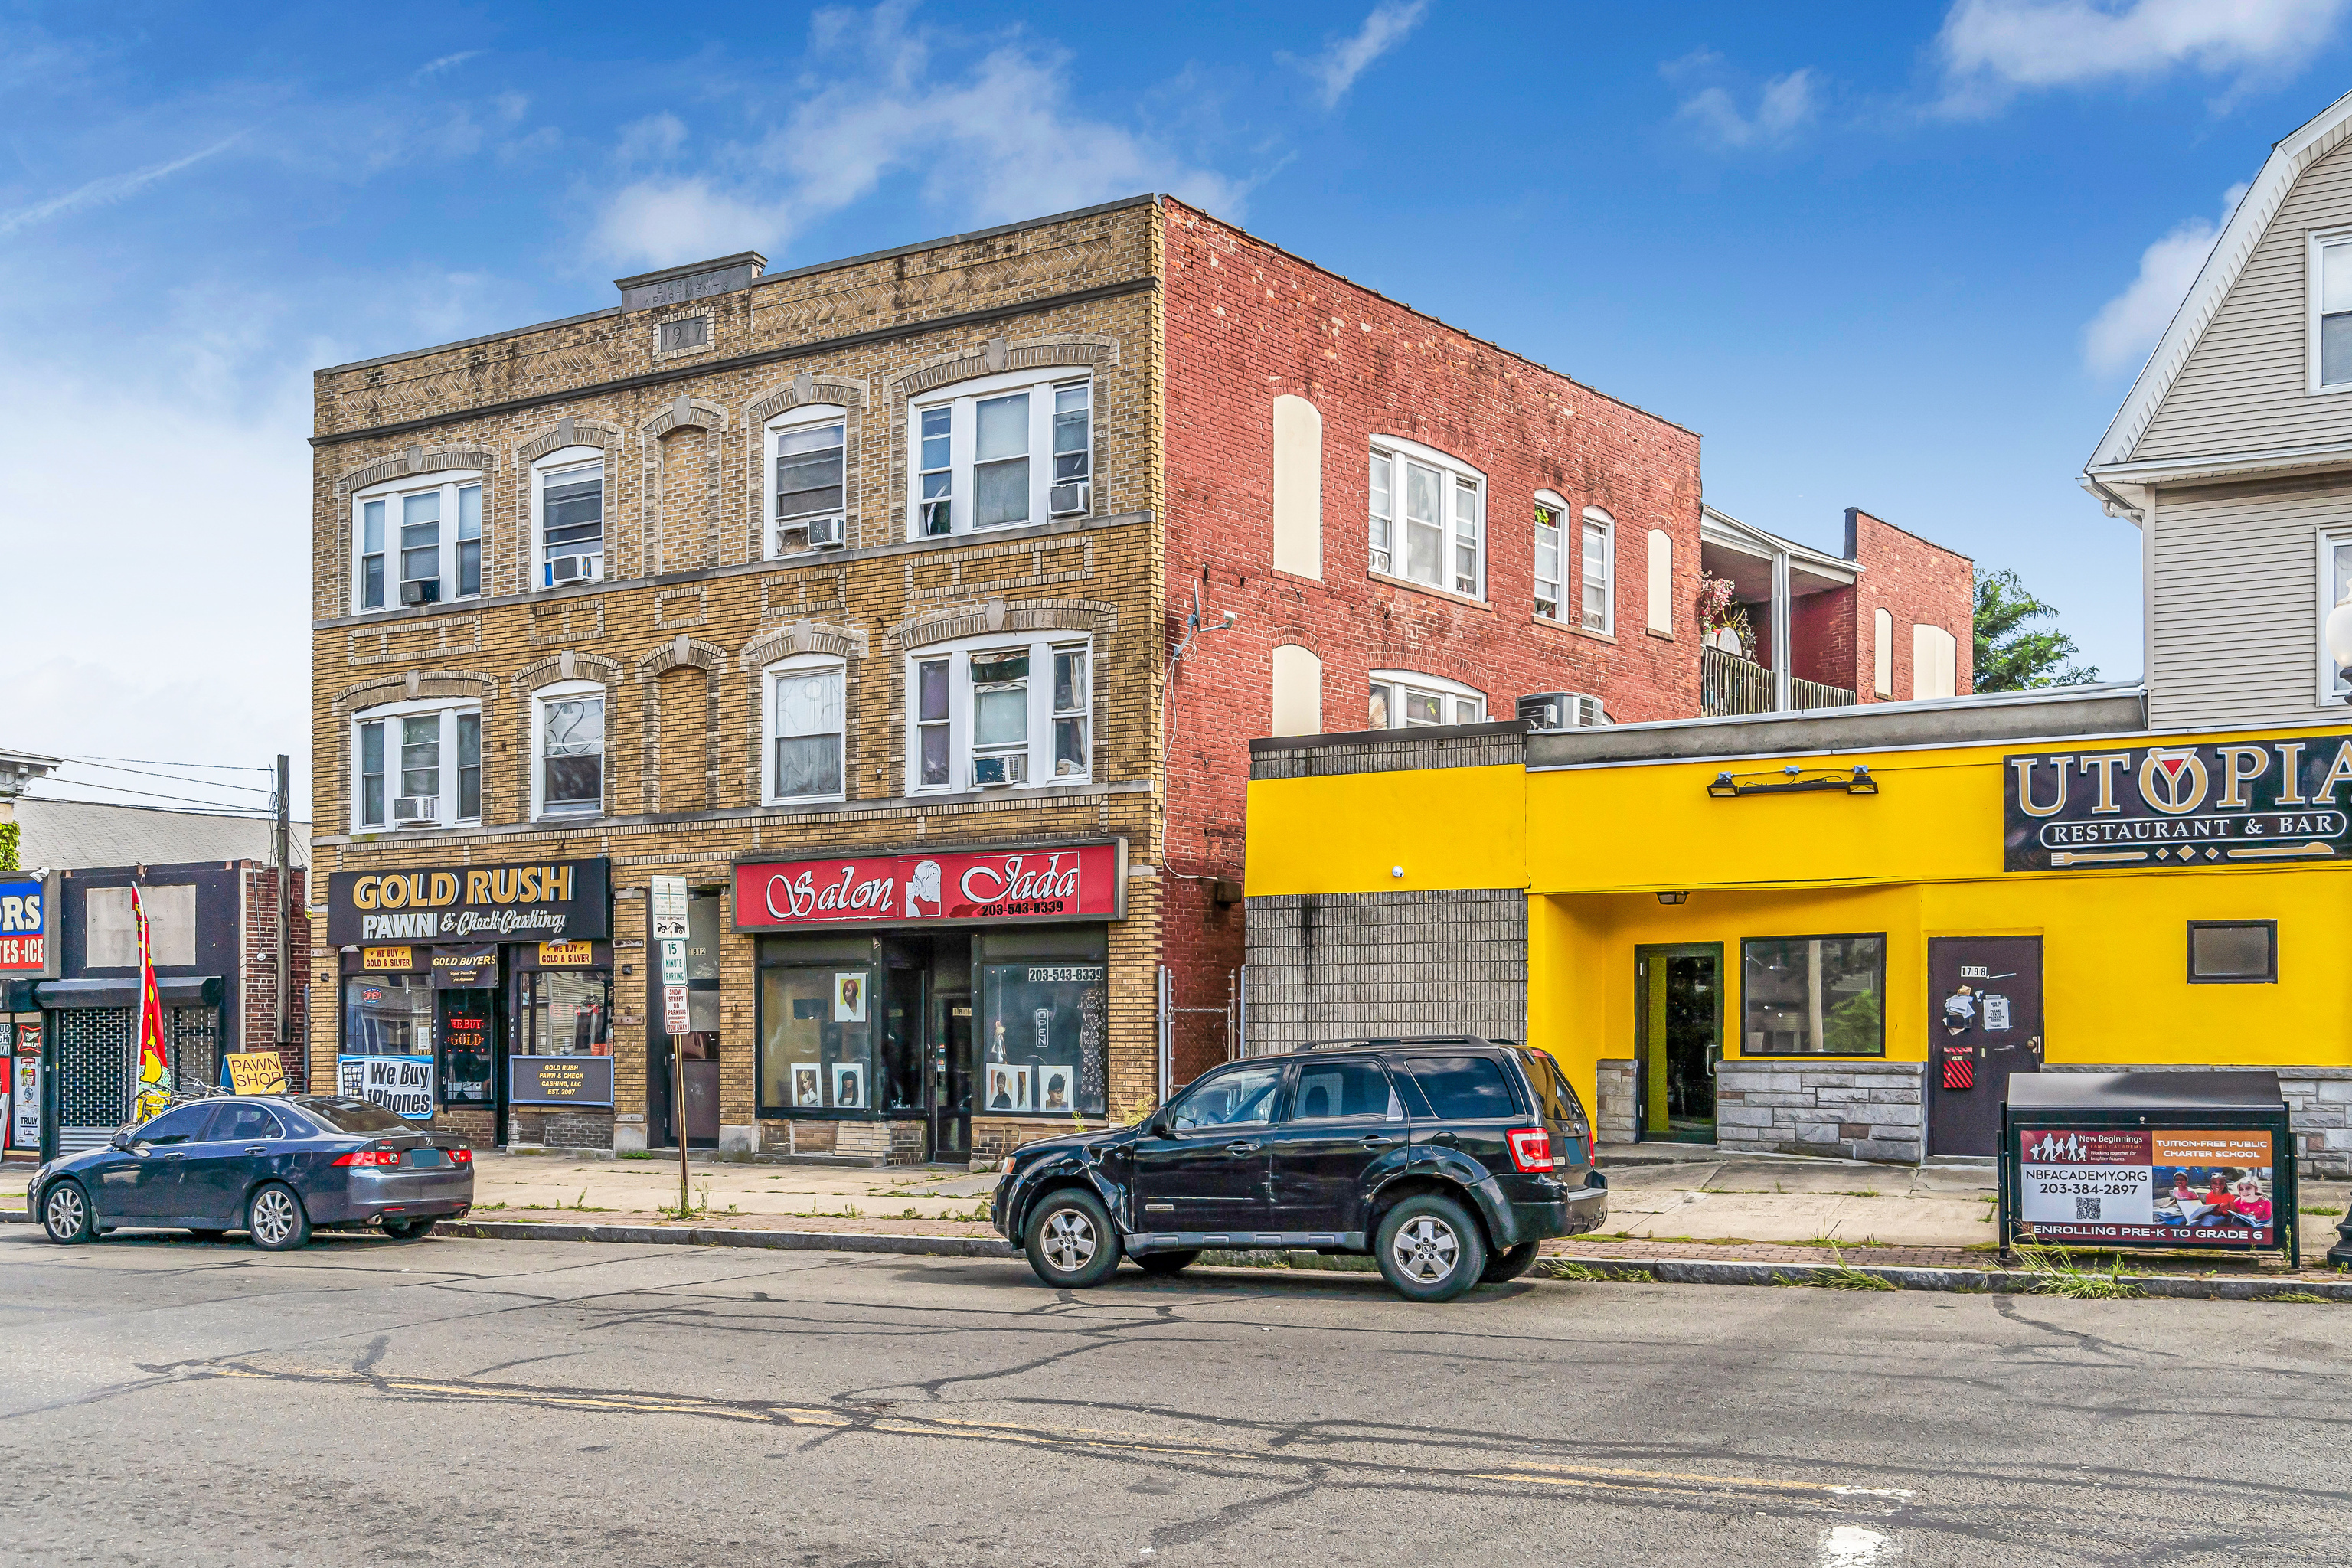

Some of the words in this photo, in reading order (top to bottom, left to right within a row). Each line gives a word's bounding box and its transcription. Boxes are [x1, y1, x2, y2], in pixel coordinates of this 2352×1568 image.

[657, 273, 715, 294] BARNUM
[645, 282, 728, 307] APARTMENTS
[664, 322, 704, 345] 1917
[2053, 819, 2230, 843] RESTAURANT
[2244, 818, 2263, 835] &
[2278, 815, 2334, 834] BAR
[353, 872, 459, 910] GOLD
[466, 865, 573, 905] RUSH
[766, 865, 894, 918] Salon
[0, 895, 41, 931] RS
[982, 901, 1063, 916] 203-543-8339
[363, 913, 438, 939] PAWN
[440, 912, 457, 933] &
[457, 910, 500, 936] Check
[376, 949, 385, 958] WE
[387, 949, 398, 957] BUY
[565, 944, 577, 952] BUY
[668, 943, 677, 955] 15
[366, 959, 381, 967] GOLD
[384, 959, 387, 967] &
[390, 958, 410, 966] SILVER
[433, 956, 458, 966] GOLD
[459, 955, 496, 966] BUYERS
[541, 955, 558, 963] GOLD
[568, 954, 590, 962] SILVER
[665, 959, 682, 968] MINUTE
[666, 972, 684, 981] PARKING
[1029, 968, 1102, 981] 203-543-8339
[1962, 967, 1985, 976] 1798
[451, 1019, 464, 1029] WE
[464, 1019, 482, 1029] BUY
[1037, 1011, 1047, 1046] OPEN
[450, 1033, 482, 1046] GOLD
[231, 1057, 279, 1073] PAWN
[236, 1072, 281, 1087] SHOP
[371, 1062, 397, 1085] We
[400, 1063, 431, 1089] Buy
[368, 1089, 430, 1113] iPhones
[2099, 1135, 2143, 1144] Beginnings
[2156, 1140, 2226, 1148] TUITION-FREE
[2230, 1140, 2268, 1148] PUBLIC
[2215, 1150, 2261, 1158] SCHOOL
[2026, 1169, 2148, 1181] NBFACADEMY.ORG
[2040, 1183, 2138, 1195] 203-384-2897
[2033, 1225, 2117, 1236] ENROLLING
[2121, 1227, 2167, 1237] PRE-K
[2170, 1228, 2191, 1238] TO
[2195, 1229, 2249, 1240] GRADE
[2252, 1230, 2263, 1240] 6
